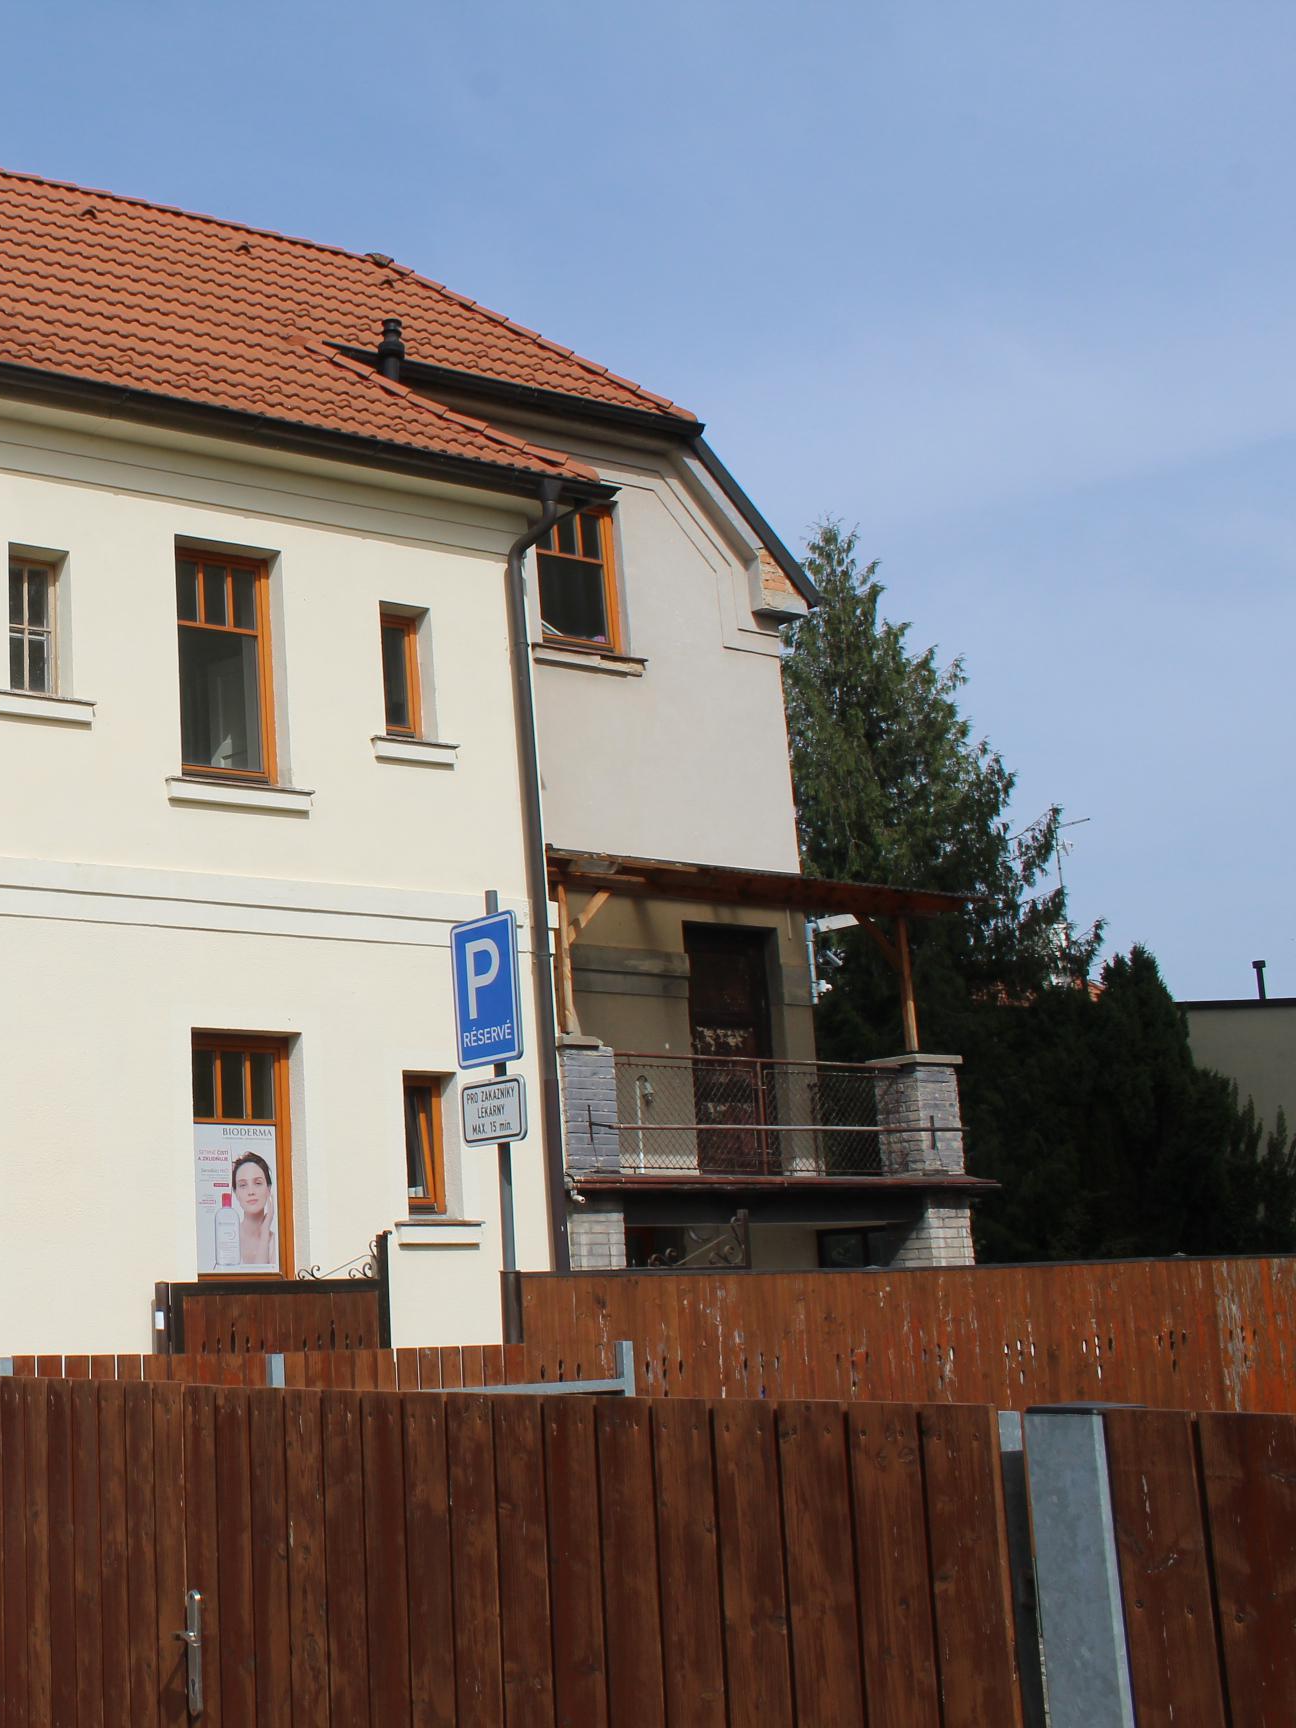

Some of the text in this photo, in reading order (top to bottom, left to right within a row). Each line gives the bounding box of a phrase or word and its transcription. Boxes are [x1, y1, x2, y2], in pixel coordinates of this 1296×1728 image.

[465, 938, 500, 1020] P
[464, 1020, 512, 1047] RÉSERVÉ
[466, 1093, 479, 1104] PRO
[477, 1104, 505, 1119] LÉKÁRNY
[222, 1127, 272, 1137] BIODERMA
[472, 1120, 512, 1135] MAX. 15 min.
